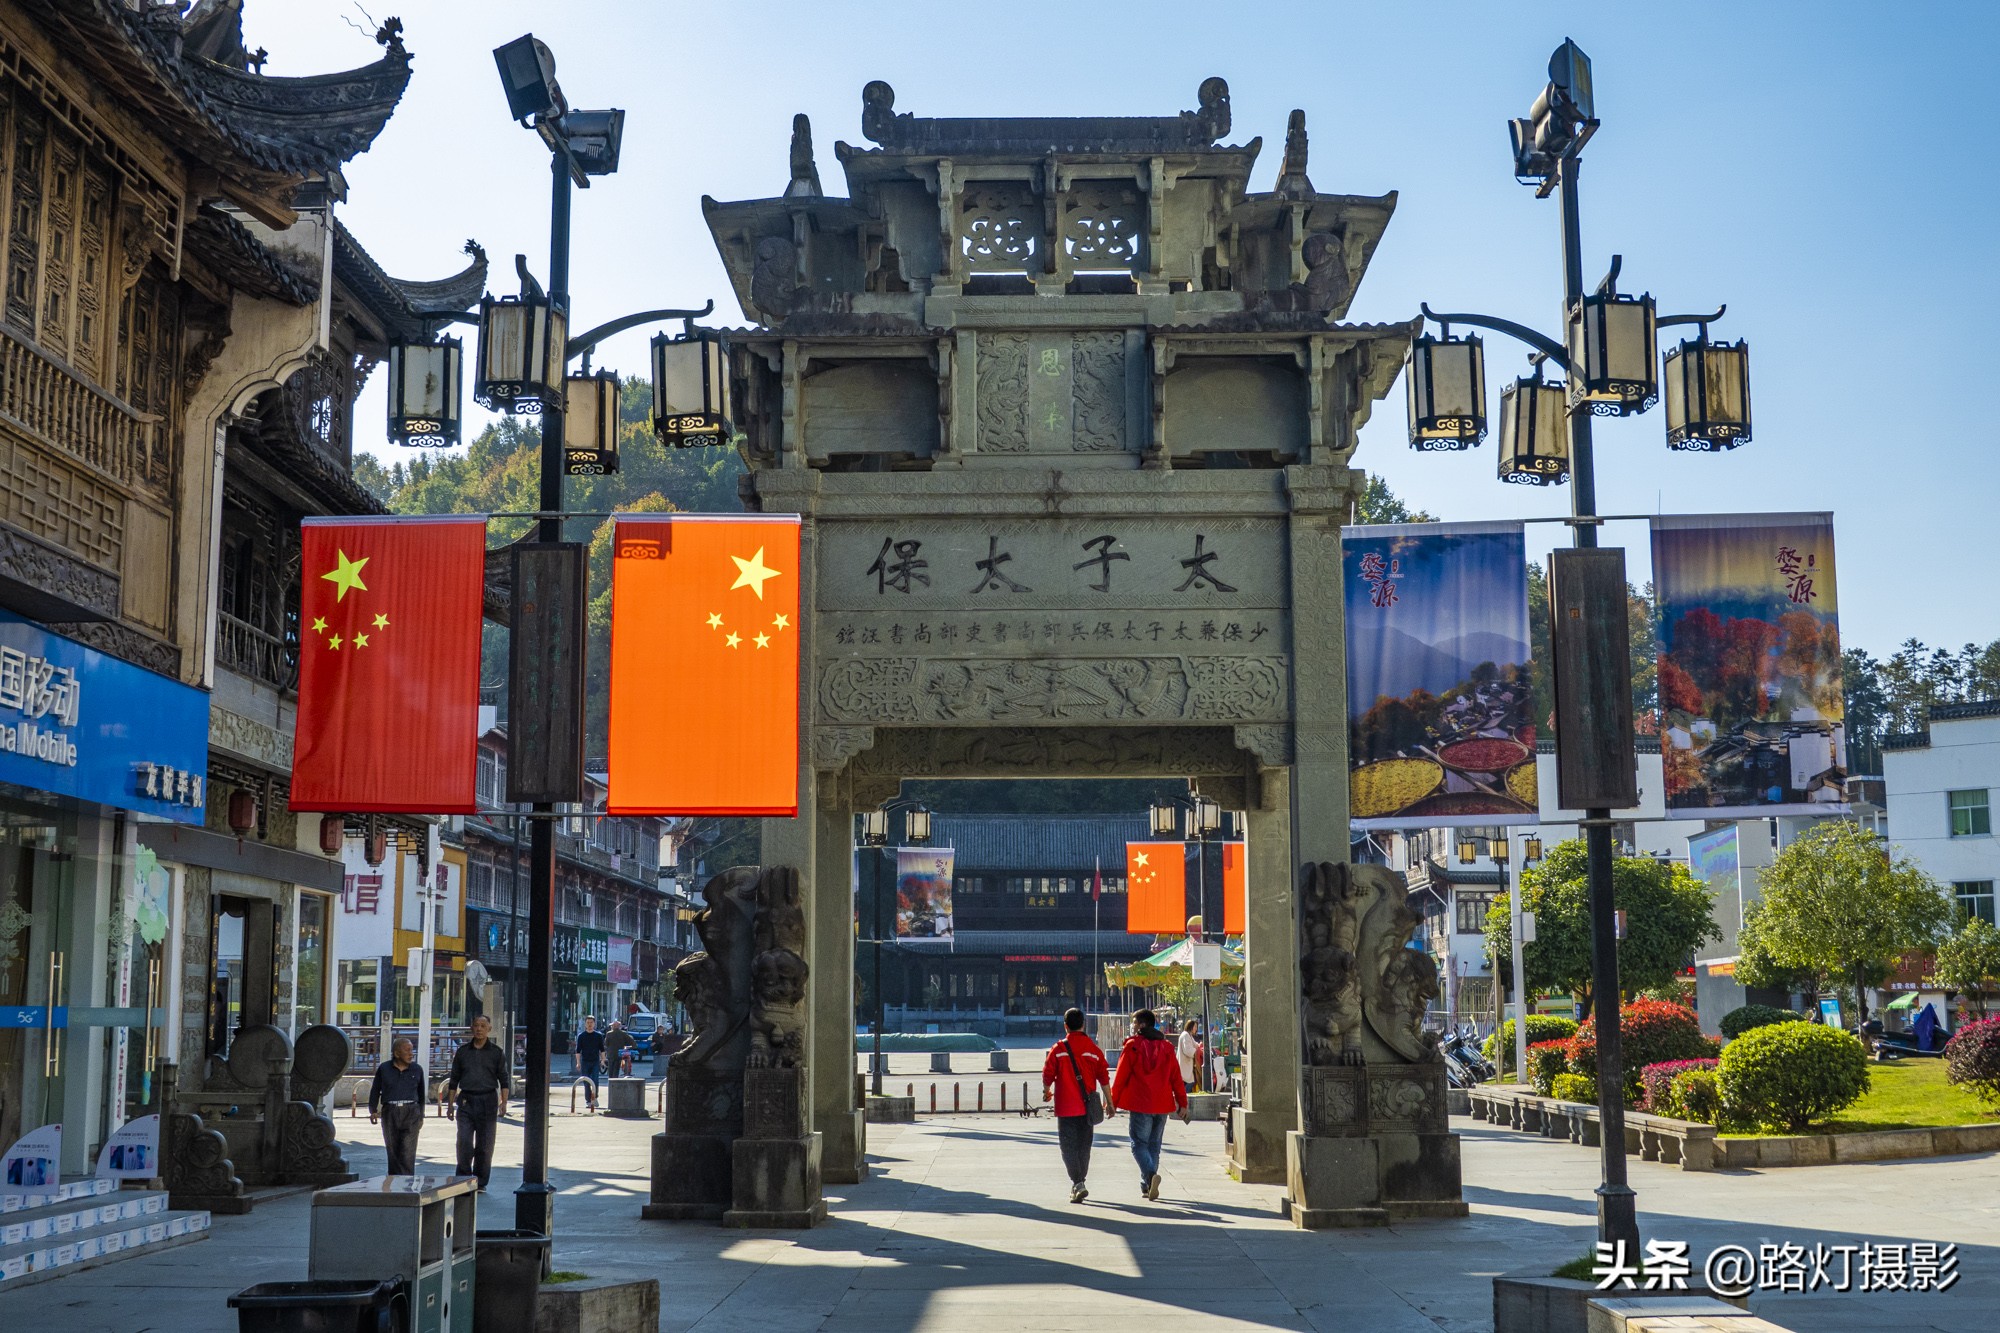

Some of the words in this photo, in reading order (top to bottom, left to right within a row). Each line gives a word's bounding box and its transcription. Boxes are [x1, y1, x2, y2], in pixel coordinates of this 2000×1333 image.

[1358, 552, 1399, 608] 婺源
[1773, 547, 1818, 603] 婺源
[0, 645, 80, 727] 国移动
[18, 722, 77, 767] Mobile
[17, 1011, 33, 1023] 5G
